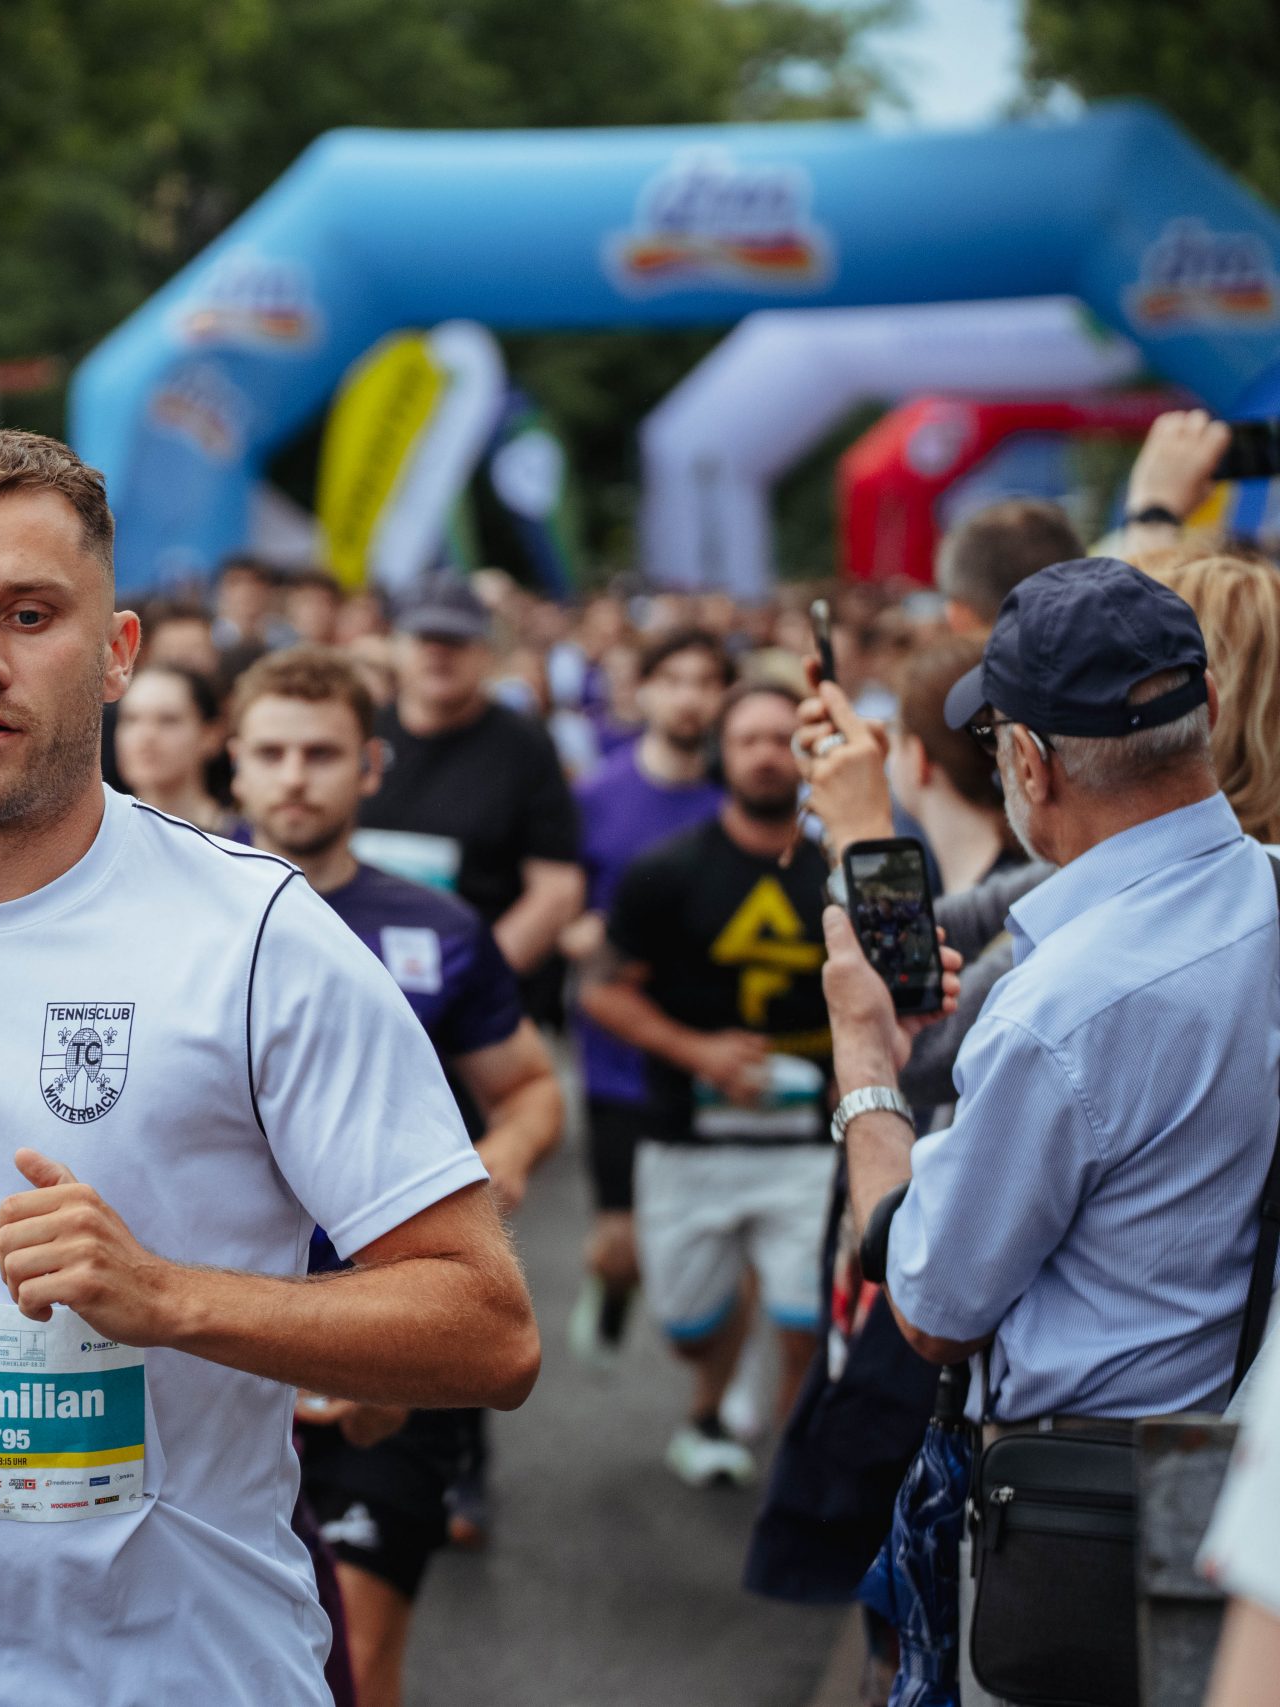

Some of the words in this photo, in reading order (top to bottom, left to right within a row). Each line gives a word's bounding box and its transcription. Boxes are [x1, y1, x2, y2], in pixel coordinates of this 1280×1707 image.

[50, 1008, 130, 1021] TENNISCLUB
[72, 1041, 101, 1066] TC
[44, 1083, 119, 1121] WINTERBACH
[12, 1457, 28, 1466] UHR
